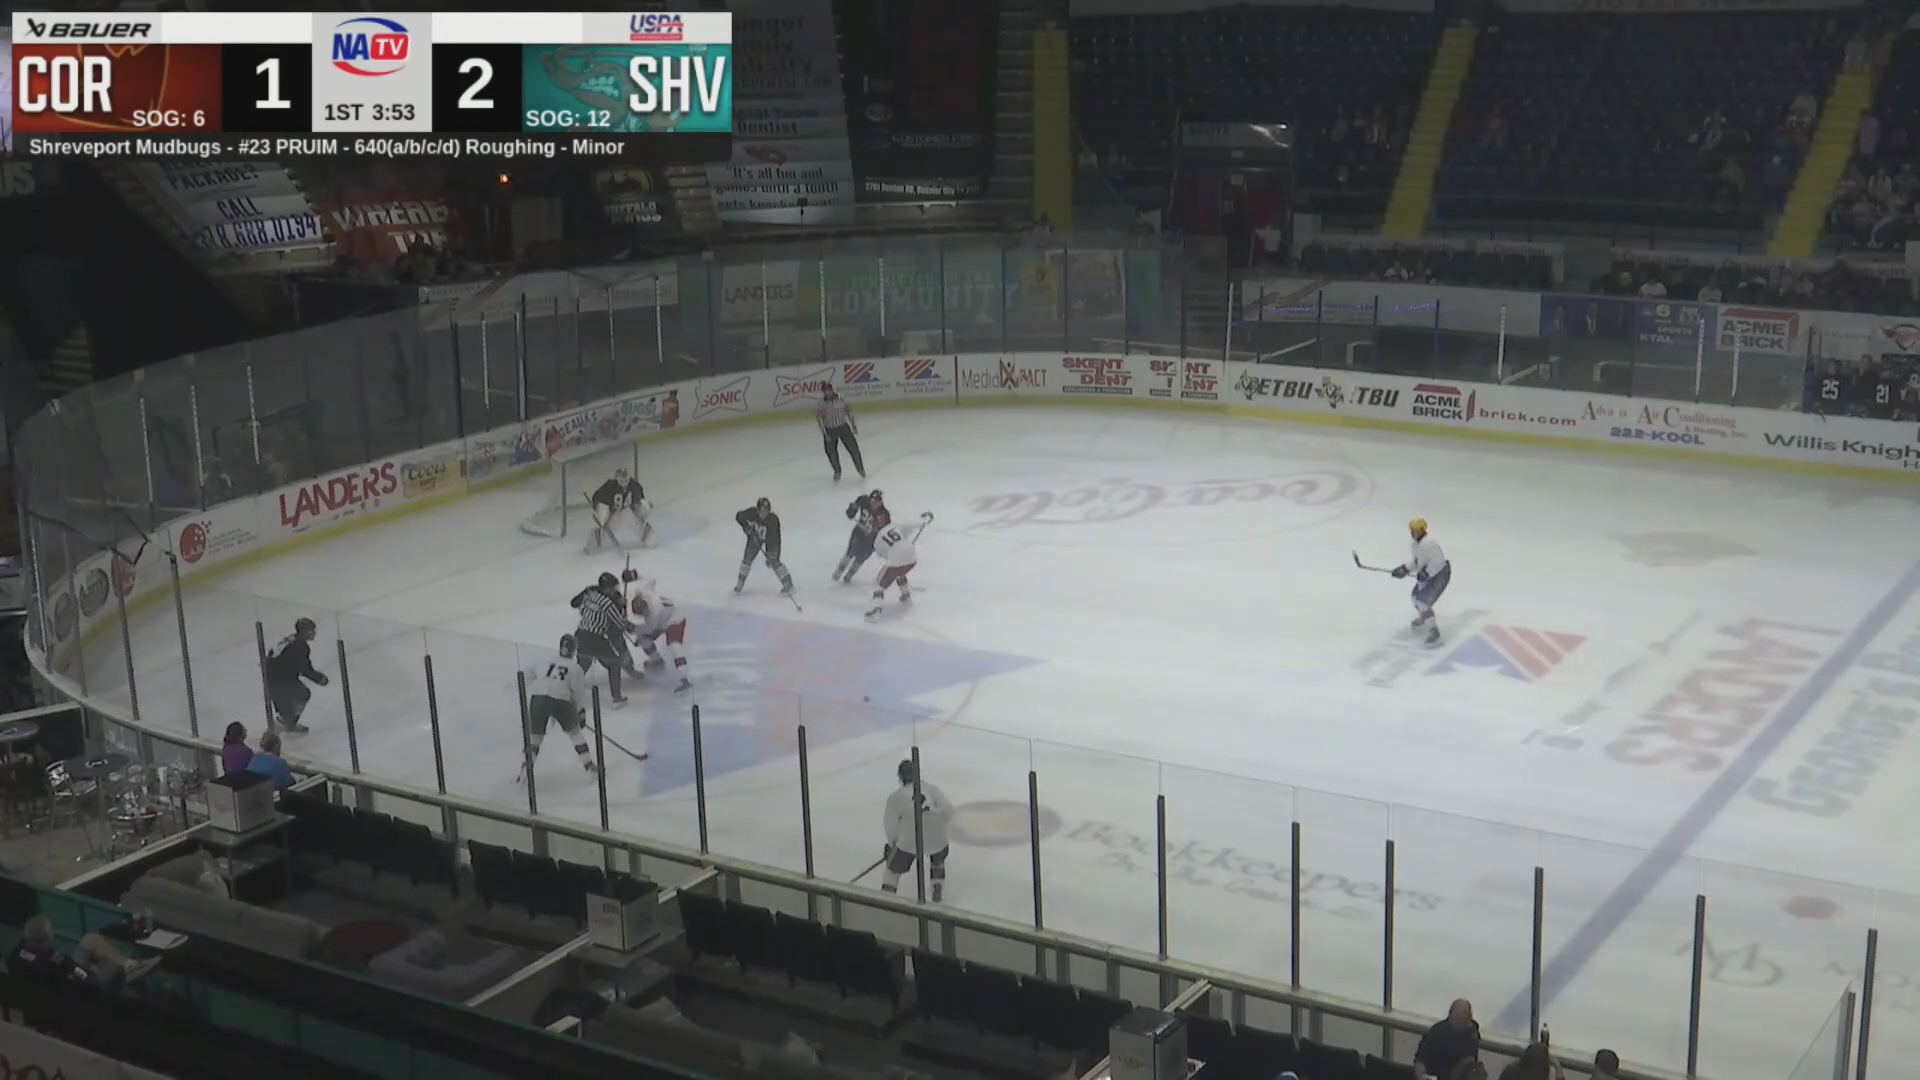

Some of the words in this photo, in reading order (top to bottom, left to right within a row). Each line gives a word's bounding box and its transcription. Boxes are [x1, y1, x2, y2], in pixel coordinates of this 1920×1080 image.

[217, 197, 263, 220] CALL
[1821, 379, 1840, 400] 25
[1875, 383, 1890, 403] 21
[1413, 394, 1462, 408] ACME
[1412, 405, 1463, 420] BRICK
[1479, 407, 1577, 426] brick.com
[1610, 426, 1705, 445] 222-KOOL
[1764, 432, 1838, 451] Willis
[279, 461, 398, 528] LANDERS
[881, 527, 901, 548] 16
